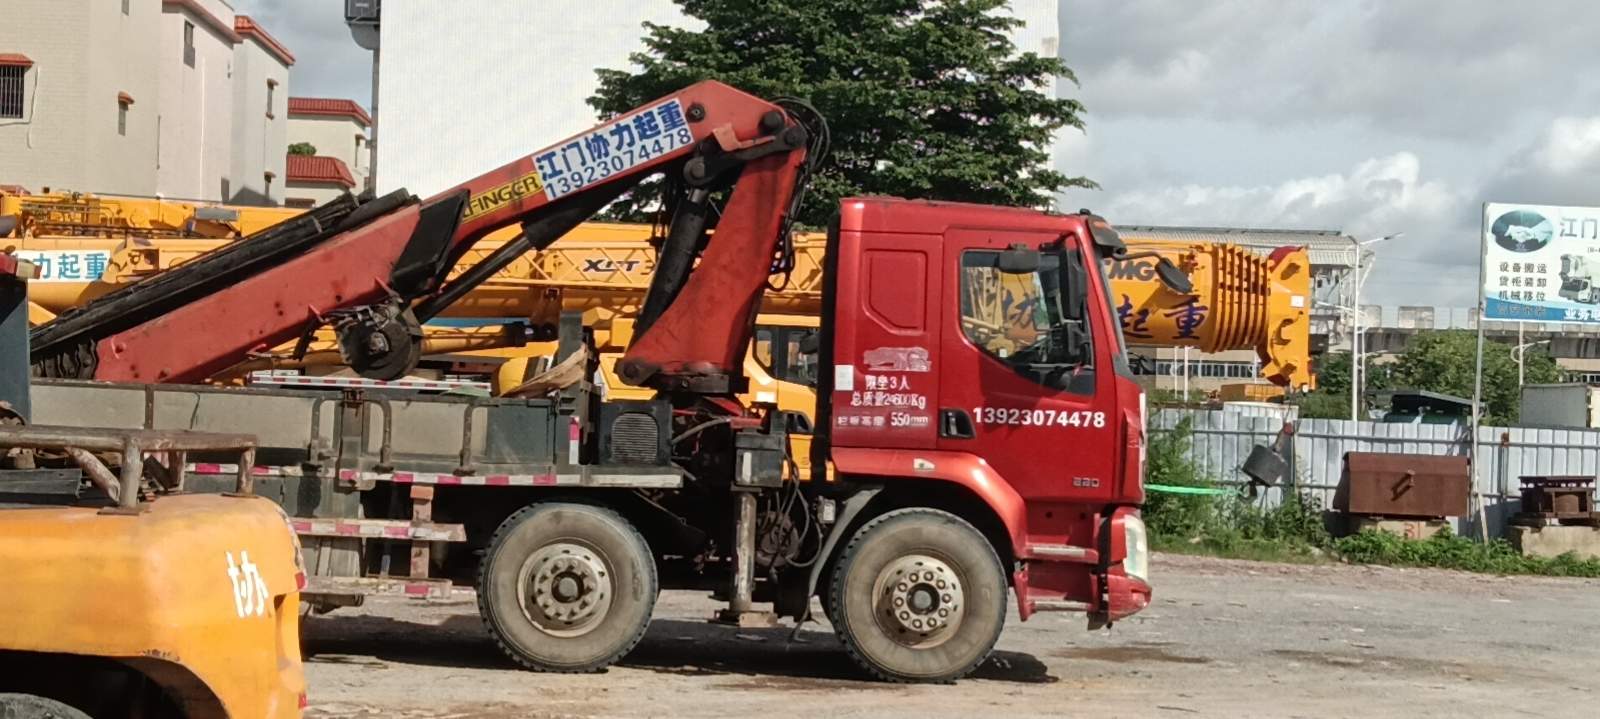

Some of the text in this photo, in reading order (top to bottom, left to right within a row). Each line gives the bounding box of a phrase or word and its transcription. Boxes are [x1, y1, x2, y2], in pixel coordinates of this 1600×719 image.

[535, 100, 688, 182] 江门协力起重
[545, 127, 692, 198] 13923074478
[1559, 216, 1598, 240] 江门
[14, 252, 107, 279] 力起重
[972, 406, 1106, 429] 13923074478
[225, 549, 269, 618] 协
